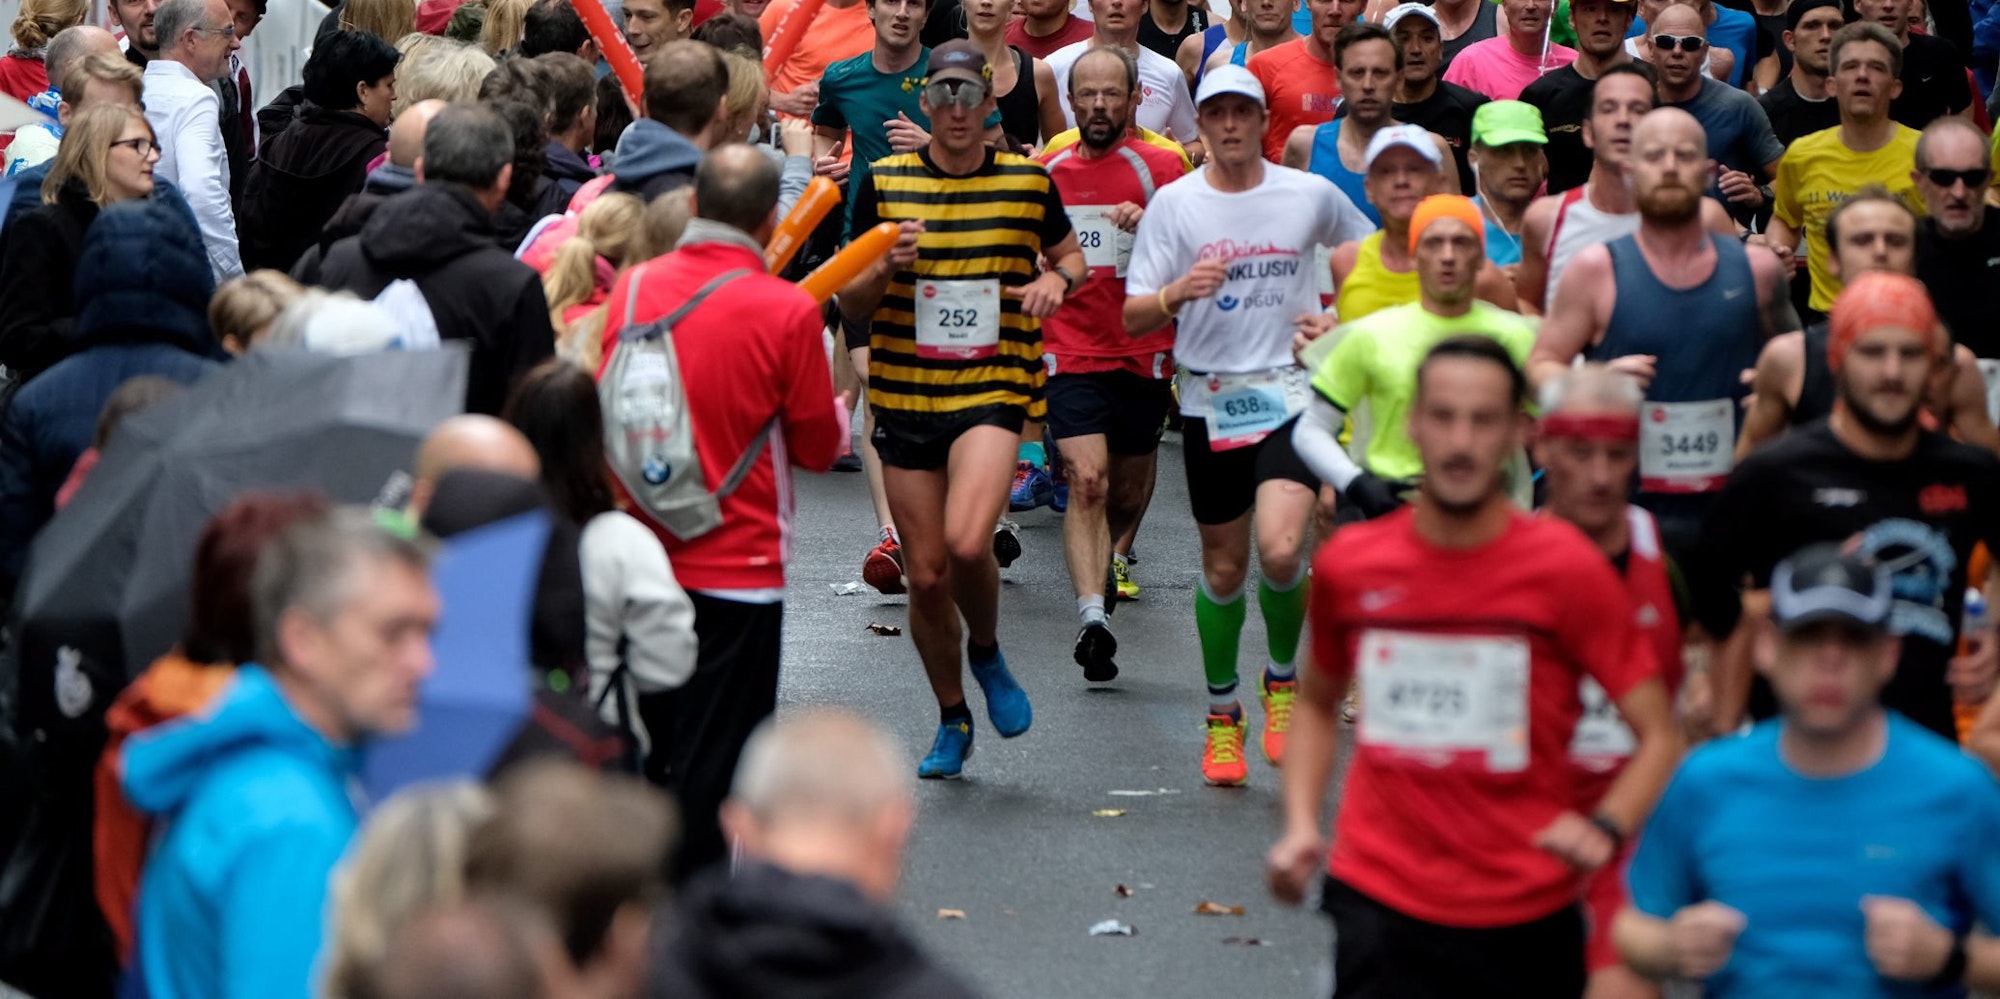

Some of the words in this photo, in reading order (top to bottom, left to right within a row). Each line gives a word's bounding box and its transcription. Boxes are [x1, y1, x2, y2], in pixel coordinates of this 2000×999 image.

[1079, 230, 1102, 248] 28
[1225, 260, 1299, 281] NKLUSIV
[1243, 293, 1284, 309] DGUV
[938, 308, 978, 327] 252
[1660, 430, 1719, 456] 3449
